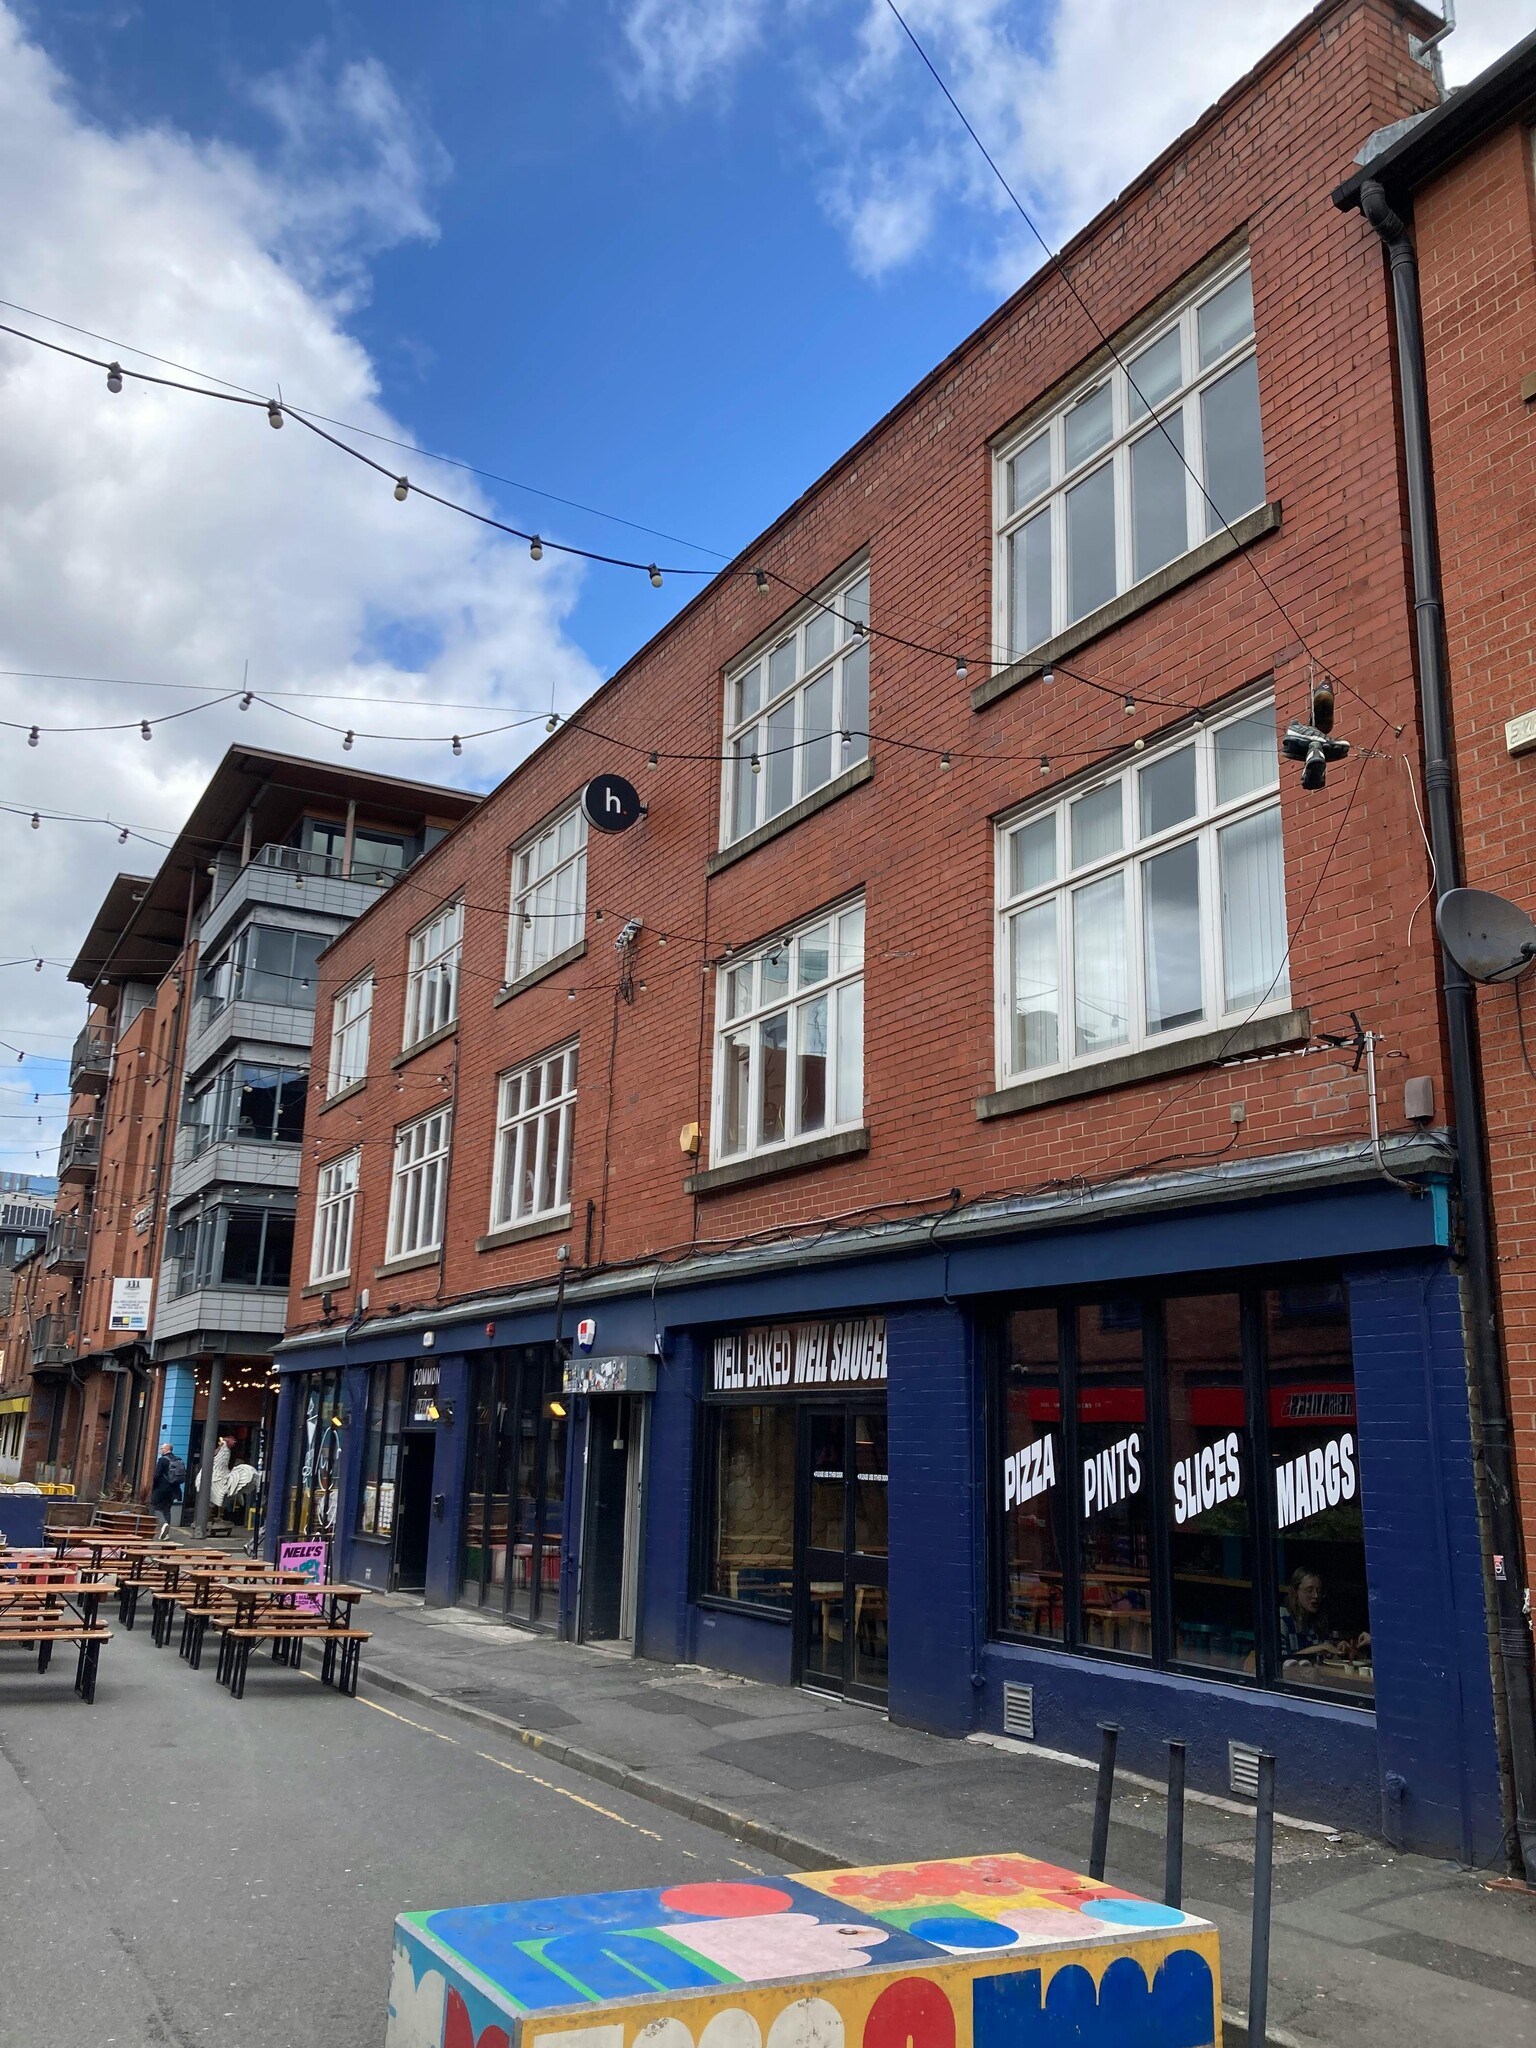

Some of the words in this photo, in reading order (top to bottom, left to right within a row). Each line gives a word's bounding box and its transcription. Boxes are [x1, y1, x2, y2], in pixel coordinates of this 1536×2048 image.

[414, 1367, 441, 1386] COMMON
[713, 1335, 744, 1390] WELL
[747, 1329, 791, 1388] BAKED
[794, 1324, 830, 1384] WELL
[1004, 1433, 1056, 1512] PIZZA
[1083, 1432, 1141, 1519] PINTS
[1173, 1432, 1241, 1525] SLICES
[1275, 1432, 1356, 1529] MARGS
[283, 1546, 323, 1558] NELL'S
